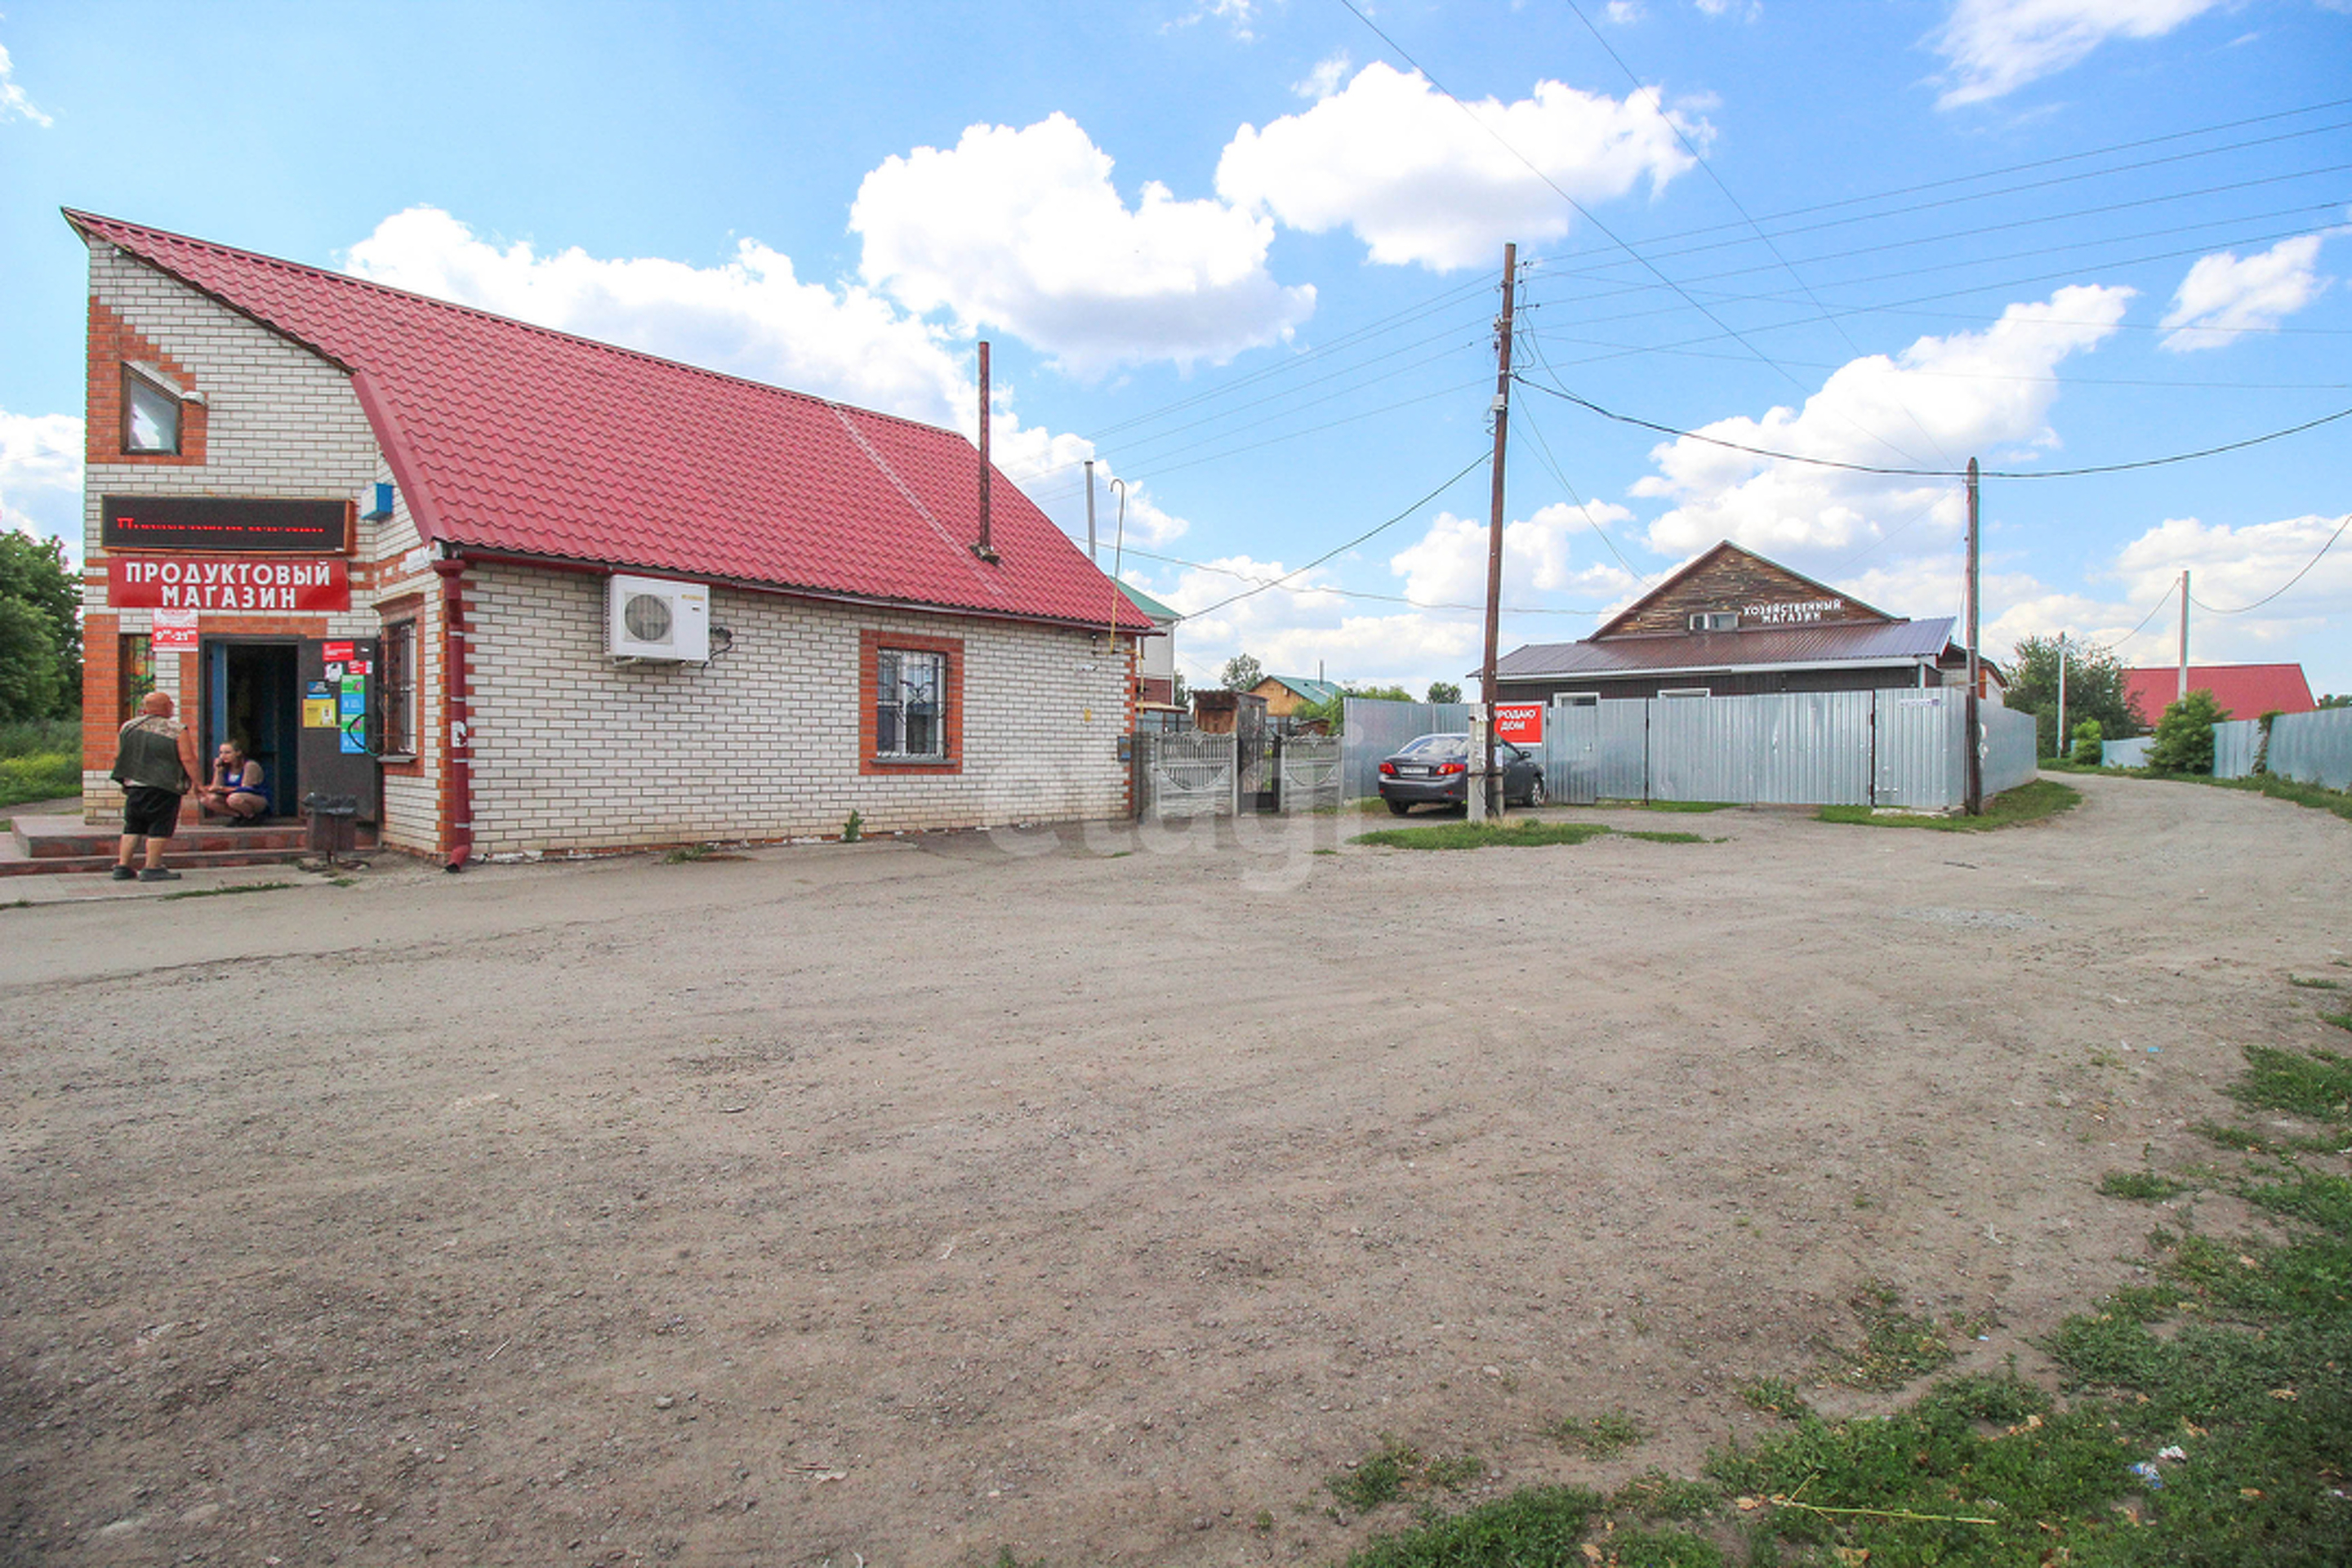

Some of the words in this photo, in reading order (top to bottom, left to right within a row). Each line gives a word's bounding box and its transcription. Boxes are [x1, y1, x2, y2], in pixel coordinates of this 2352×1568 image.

[125, 560, 331, 586] ПРОДУКТОВЫЙ
[161, 585, 296, 608] МАГАЗИН
[1762, 611, 1822, 623] МАГАЗИН
[1500, 720, 1526, 732] ДОМ
